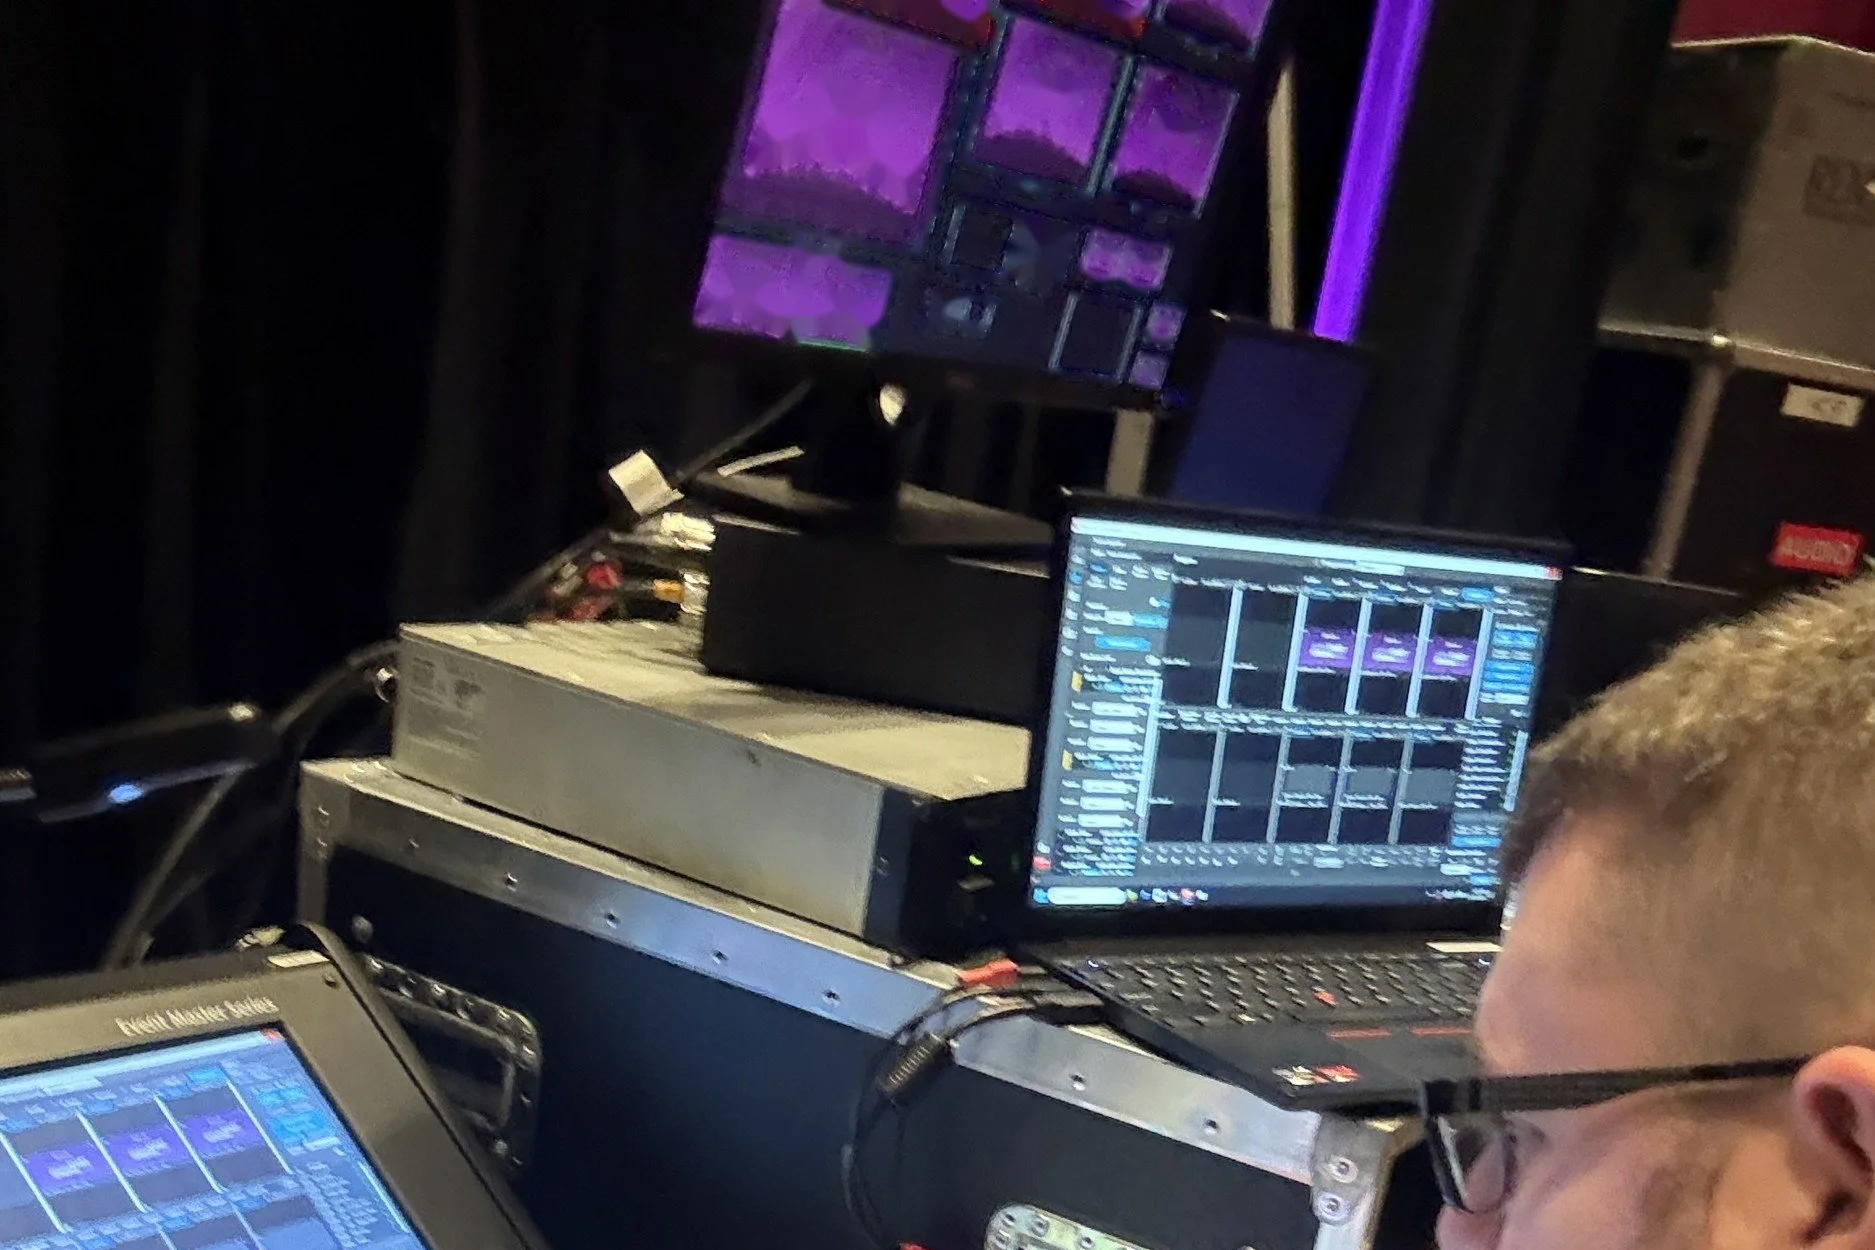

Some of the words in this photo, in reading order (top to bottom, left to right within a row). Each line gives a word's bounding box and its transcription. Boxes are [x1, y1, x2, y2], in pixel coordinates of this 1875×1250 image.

[115, 1010, 173, 1037] Event
[165, 1004, 230, 1028] Master
[223, 996, 280, 1019] Series
